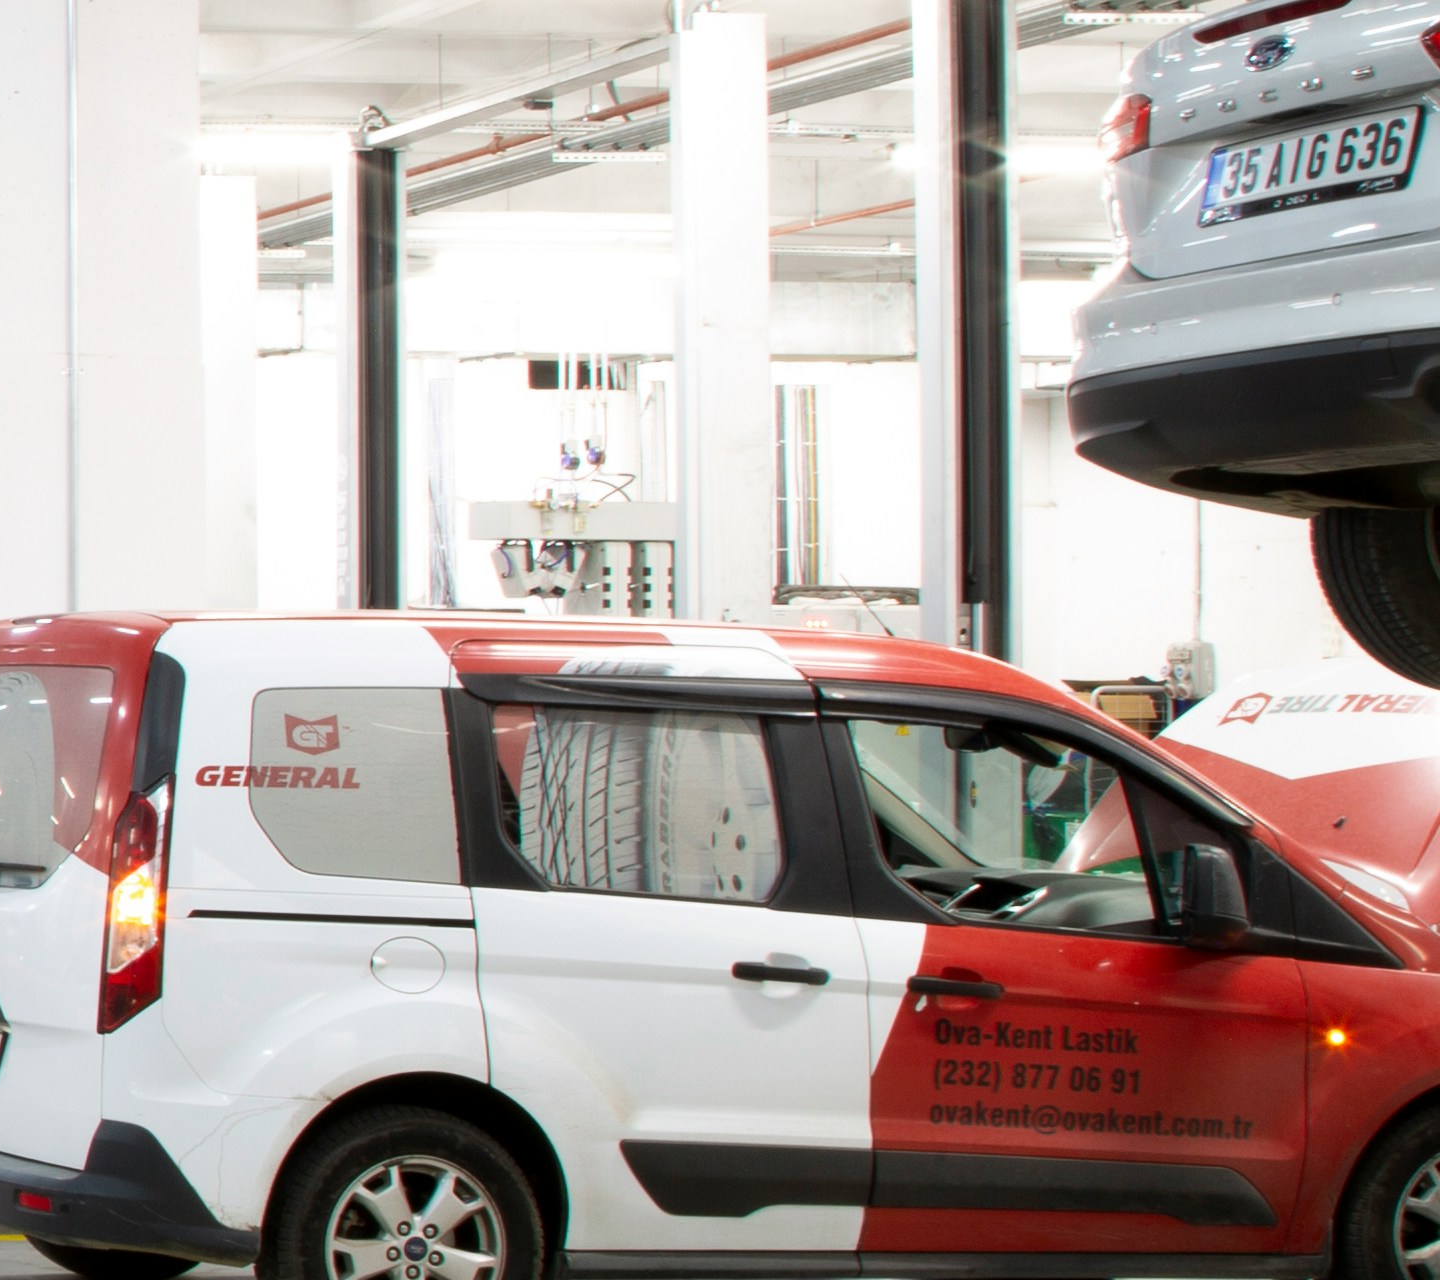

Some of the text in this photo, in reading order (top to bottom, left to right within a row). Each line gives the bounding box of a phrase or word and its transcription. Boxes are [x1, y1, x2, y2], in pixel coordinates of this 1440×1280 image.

[1179, 65, 1374, 122] FOCUS
[1223, 118, 1407, 199] 35 AIG 636
[1268, 693, 1339, 714] TIRE
[195, 765, 361, 789] GENERAL
[935, 1018, 1139, 1055] Ova-Kent Lastik
[933, 1058, 1142, 1094] (232) 877 06 91
[930, 1100, 1253, 1140] ovakent@ovakent.com.tr
